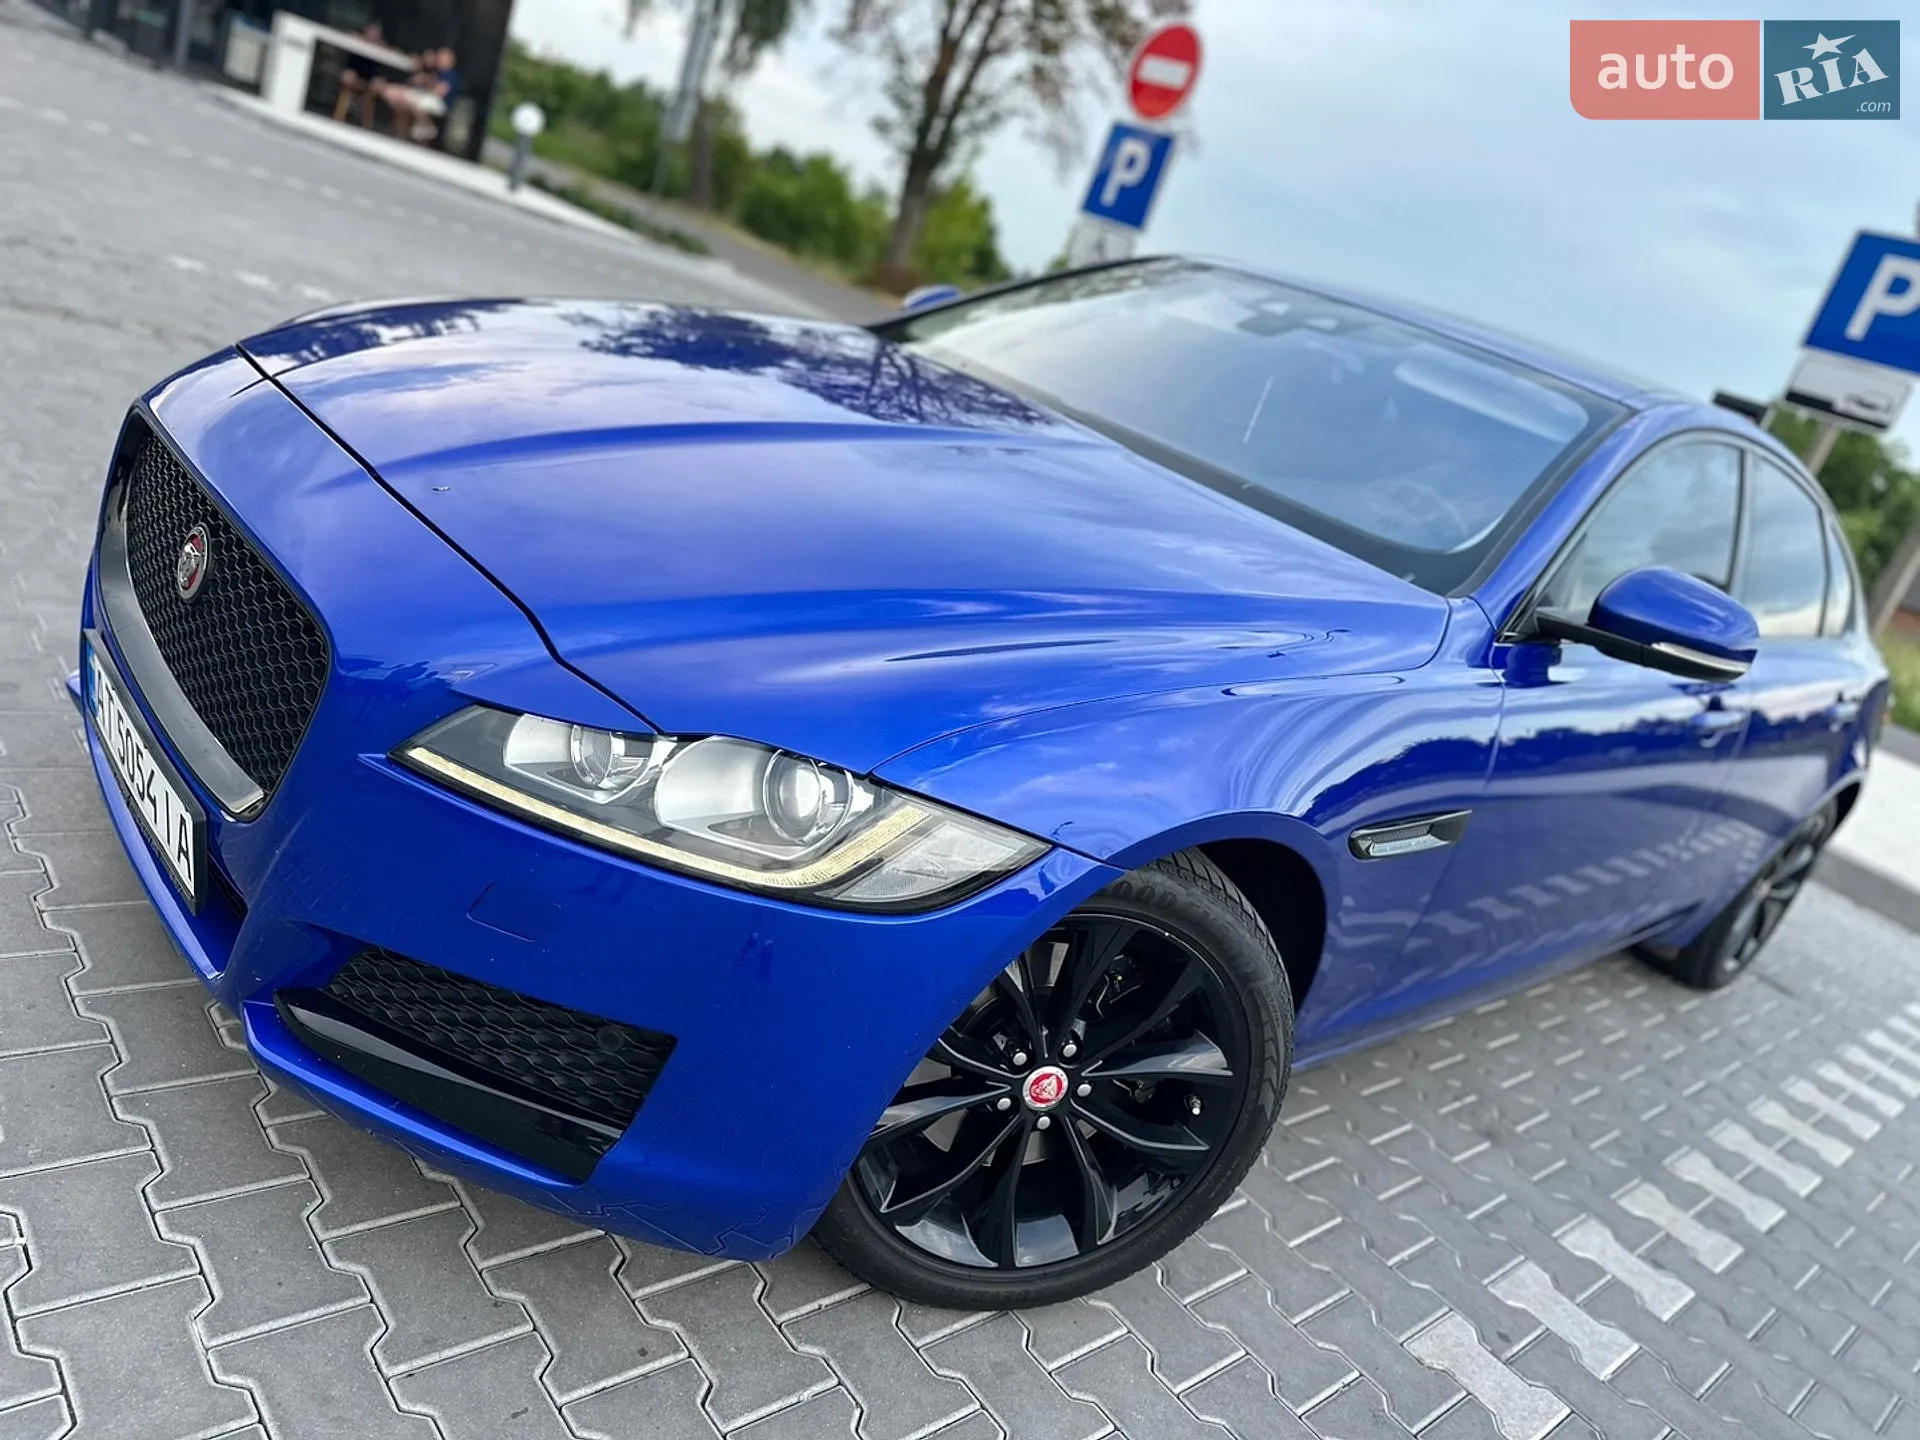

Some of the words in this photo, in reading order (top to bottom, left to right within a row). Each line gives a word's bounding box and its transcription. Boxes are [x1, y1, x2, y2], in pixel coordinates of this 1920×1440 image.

[1100, 136, 1152, 208] P
[1844, 253, 1920, 342] P
[116, 708, 158, 826] 5054
